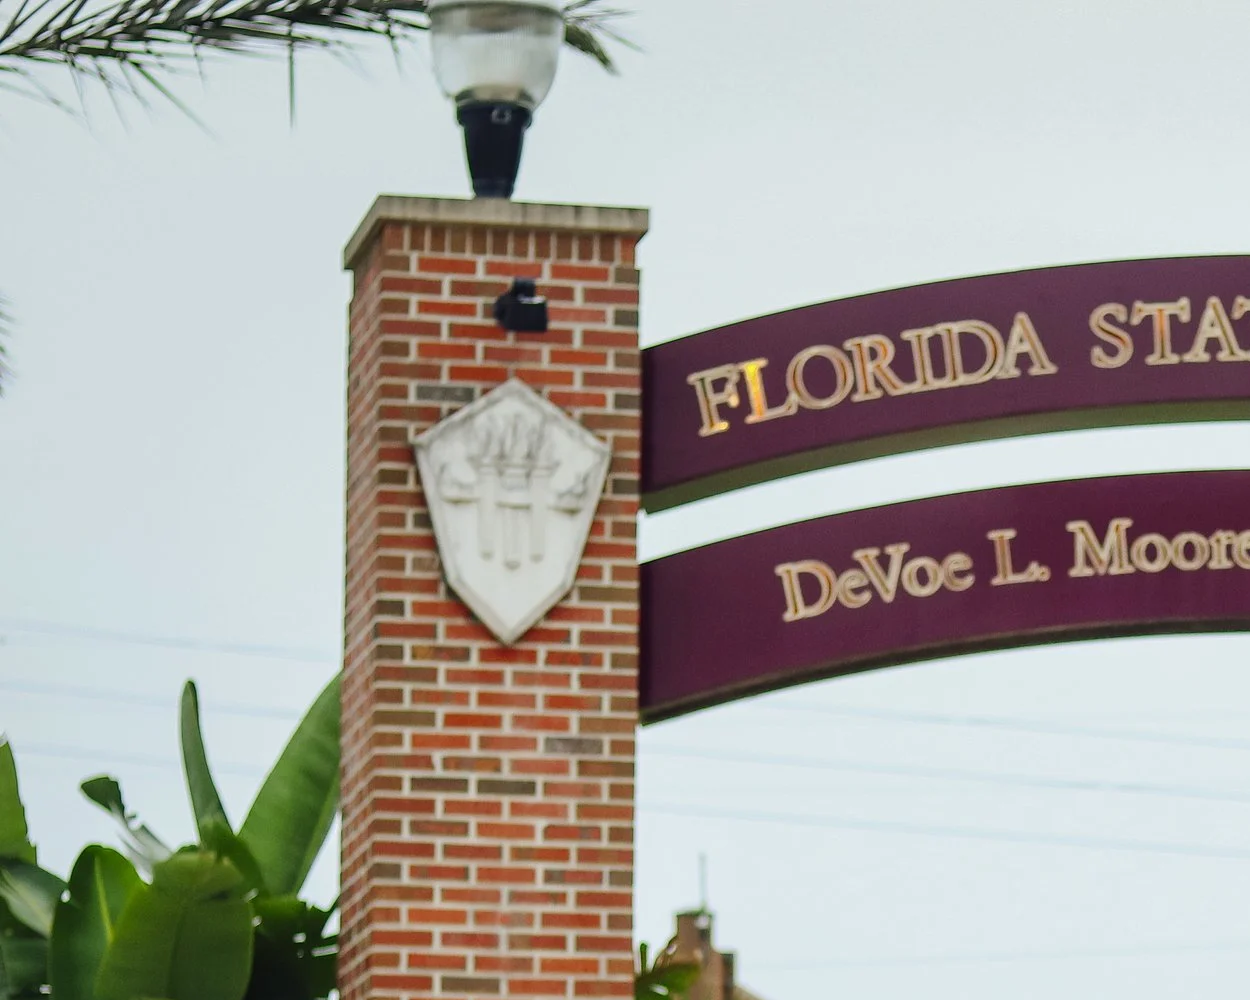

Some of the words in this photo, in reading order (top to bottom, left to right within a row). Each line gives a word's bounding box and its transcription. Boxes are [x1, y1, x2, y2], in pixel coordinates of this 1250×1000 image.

[689, 312, 1057, 436] FLORIDA
[777, 543, 974, 622] DeVoe
[988, 528, 1051, 587] L.
